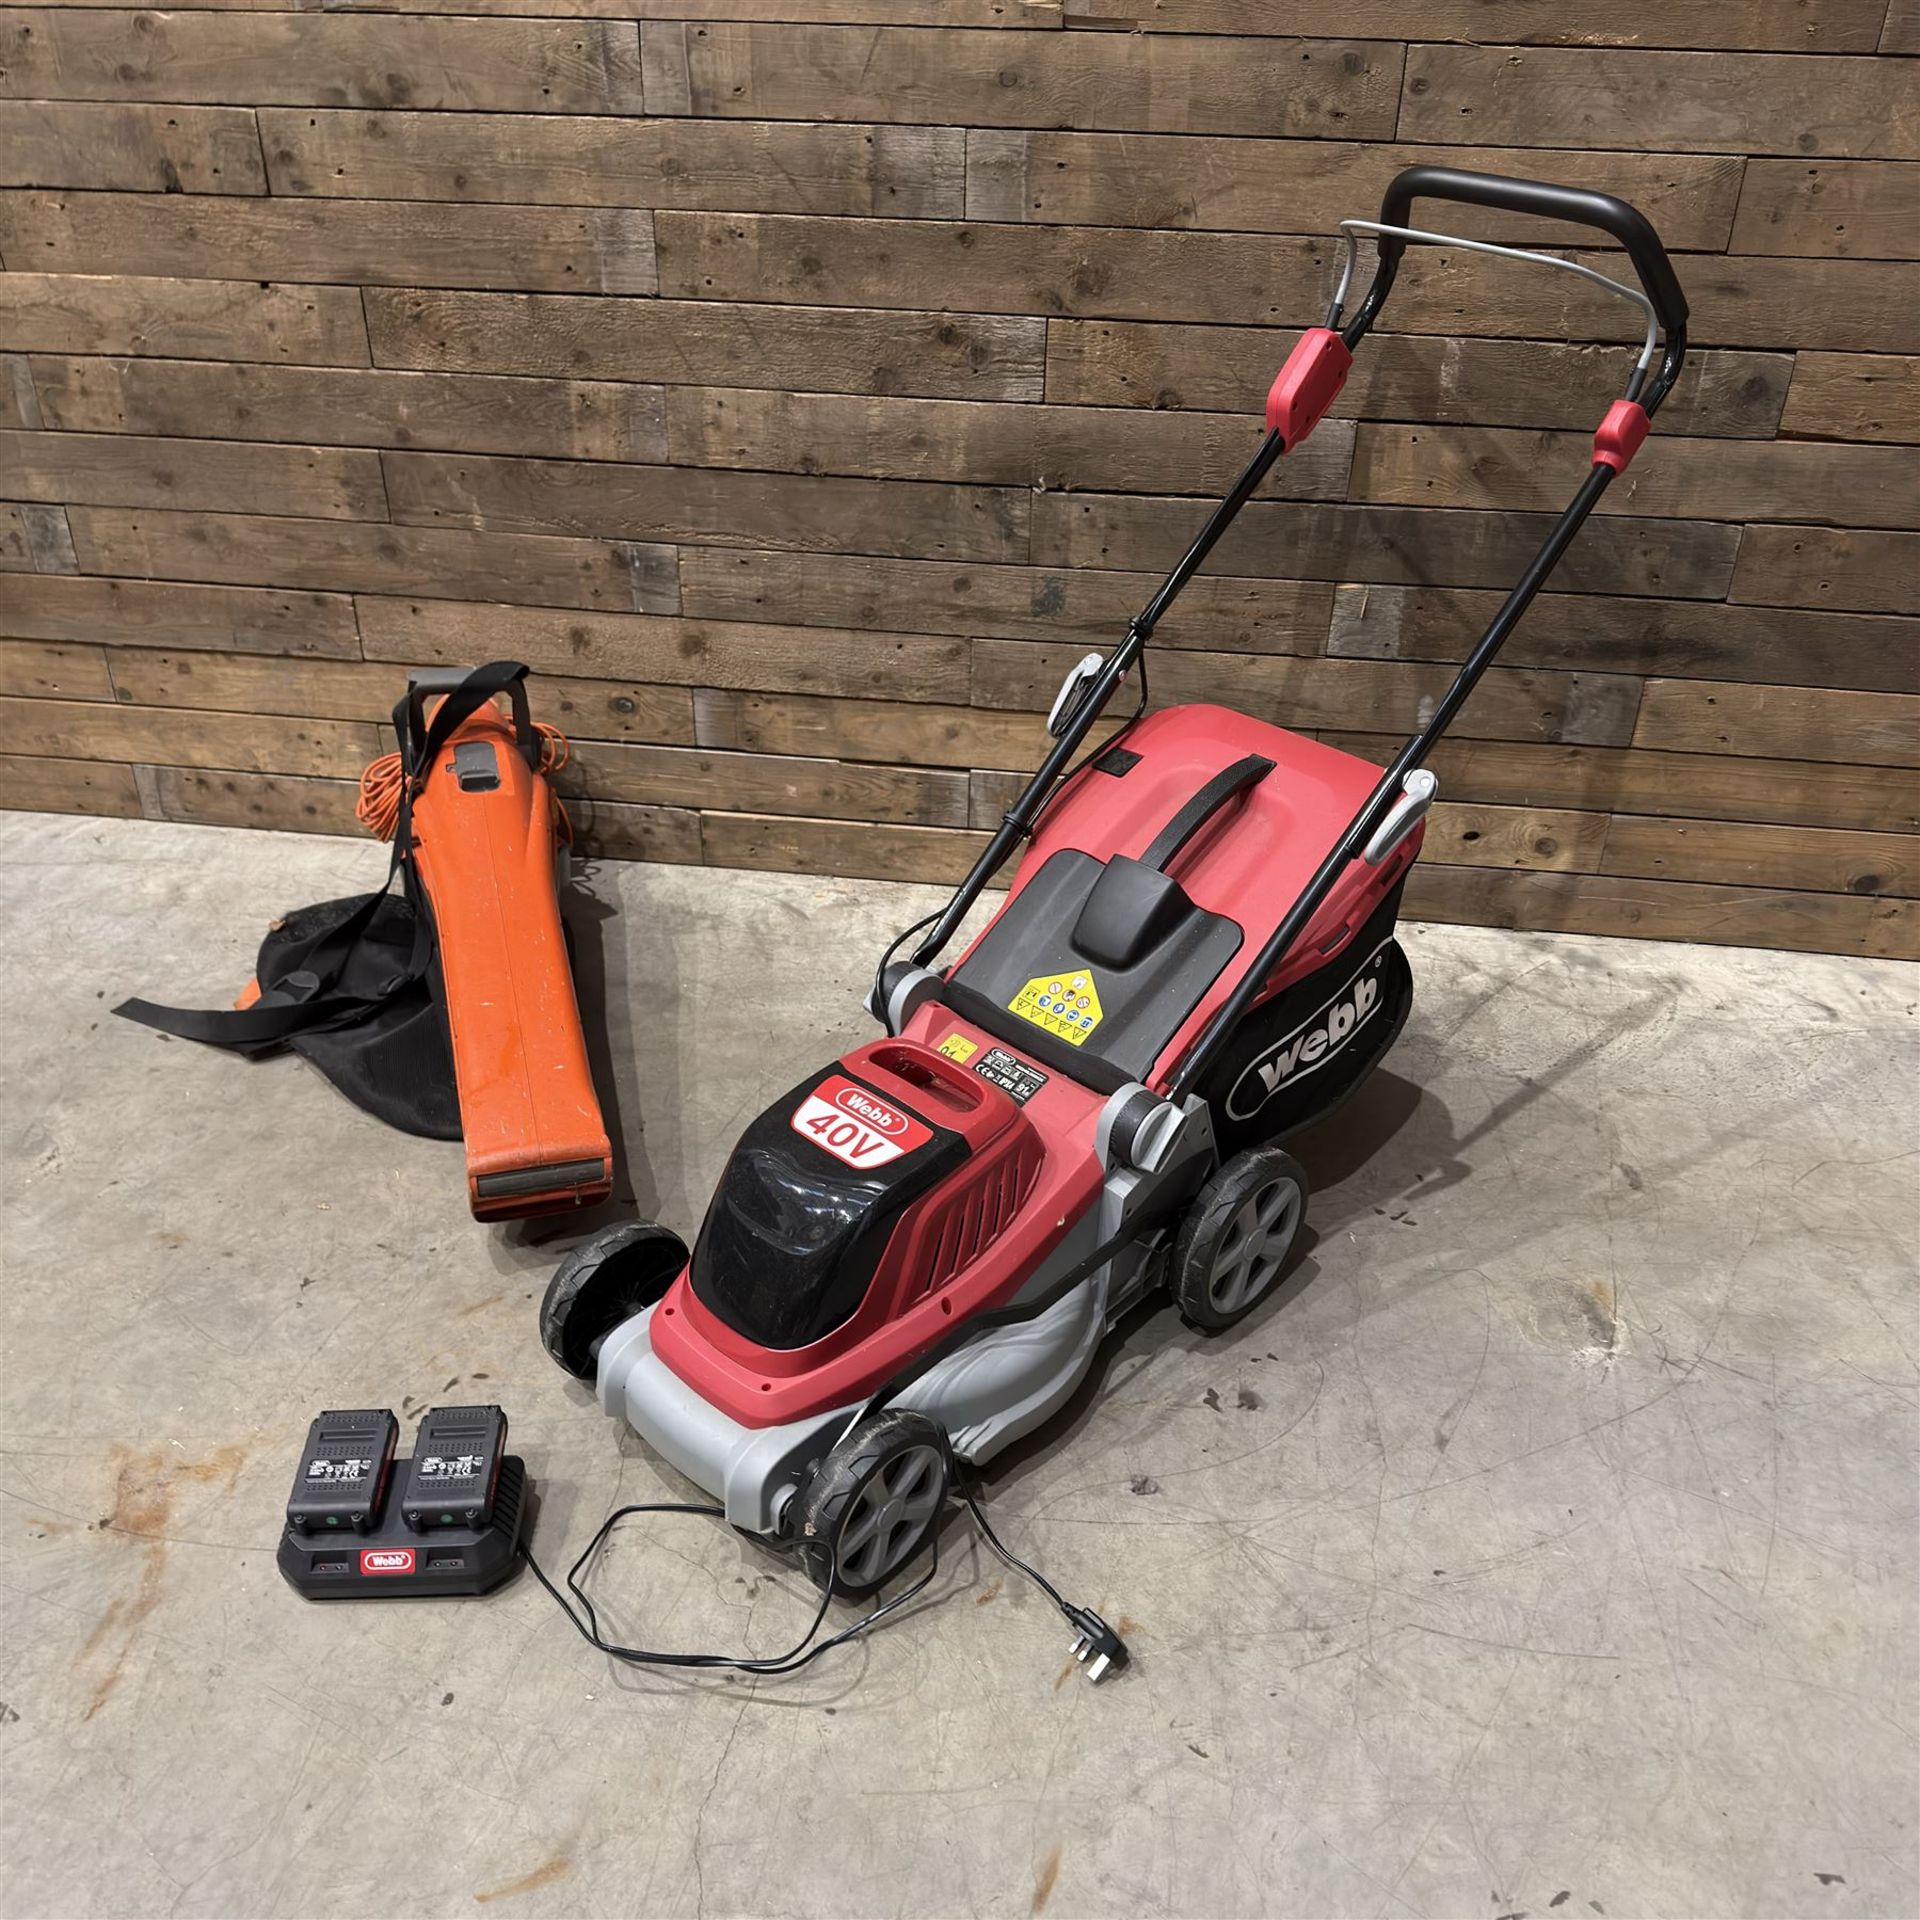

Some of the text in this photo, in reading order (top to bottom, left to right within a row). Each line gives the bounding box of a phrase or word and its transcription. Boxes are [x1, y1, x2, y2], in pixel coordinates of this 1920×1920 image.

[1258, 977, 1378, 1093] Webb
[846, 1093, 893, 1127] Webb
[806, 1113, 885, 1159] 40V
[372, 1555, 403, 1568] Webb
